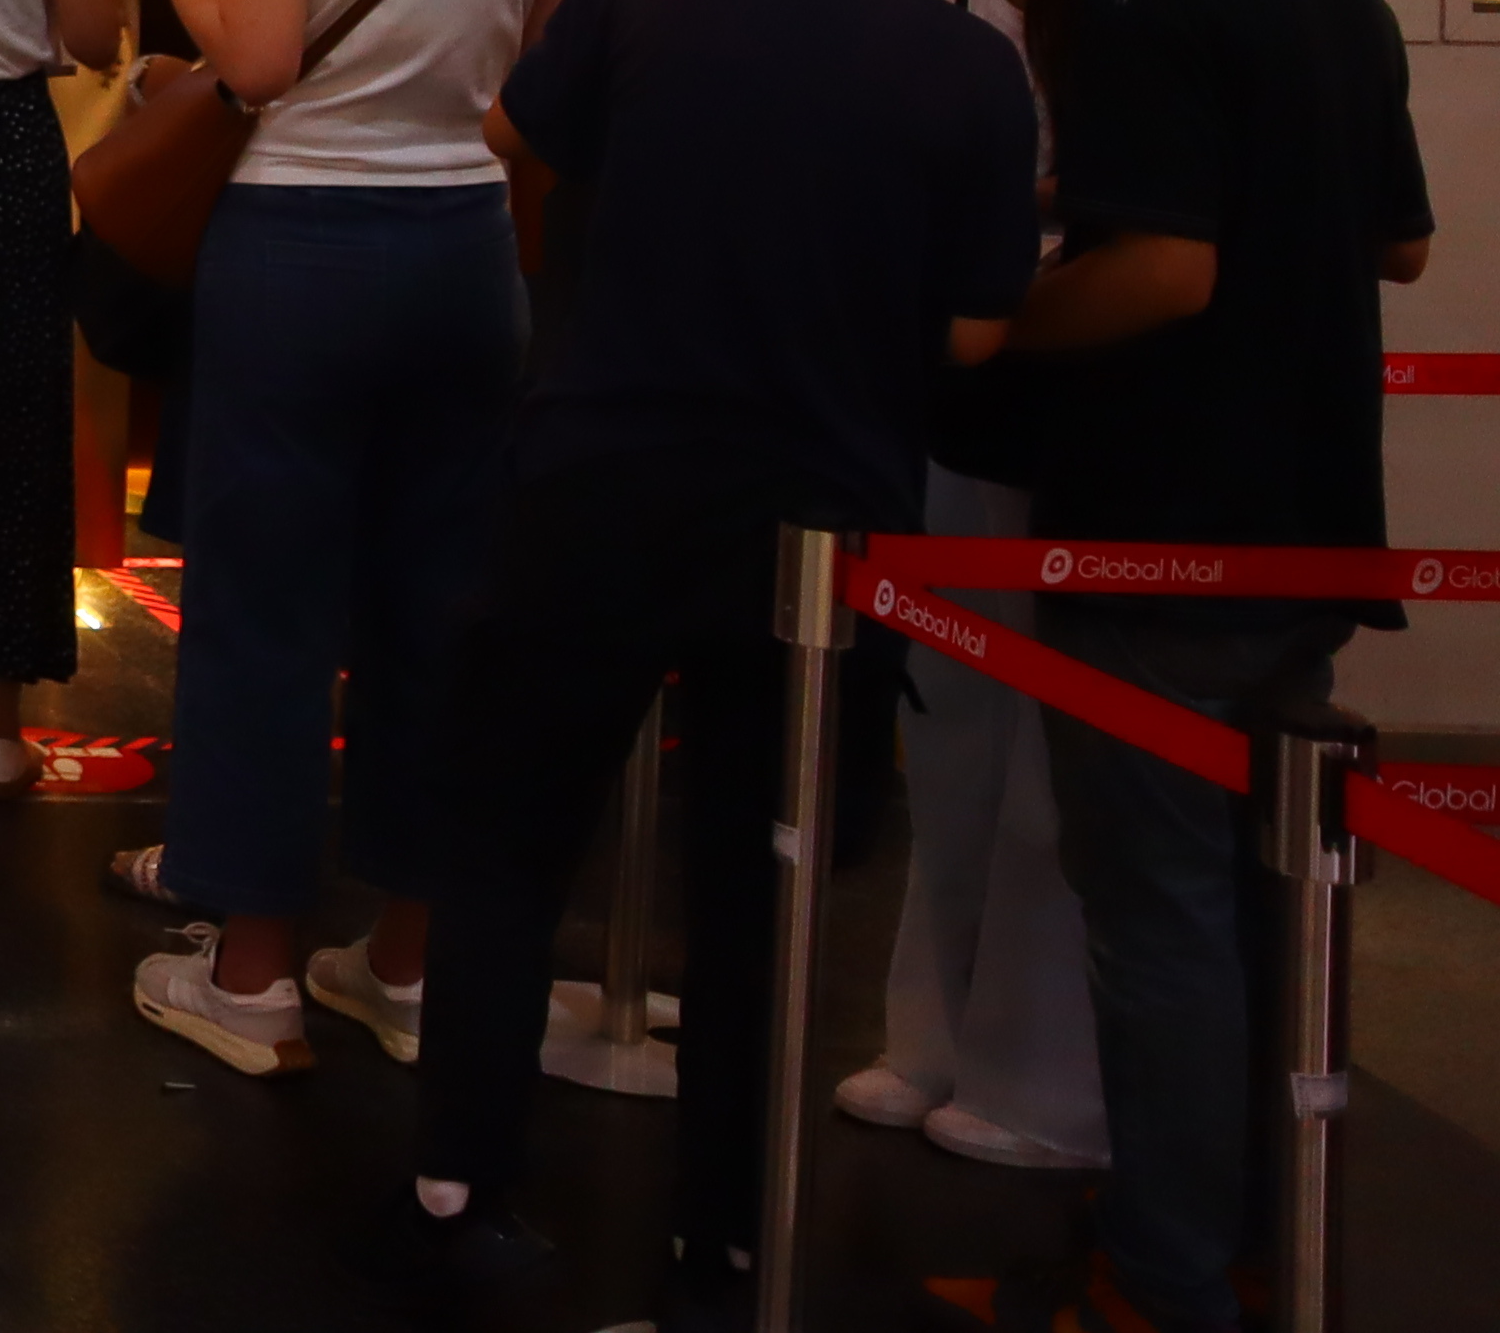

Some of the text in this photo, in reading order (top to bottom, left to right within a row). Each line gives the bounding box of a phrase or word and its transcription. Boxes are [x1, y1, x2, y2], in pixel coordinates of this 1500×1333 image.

[1077, 554, 1225, 584] Global Mall
[896, 594, 988, 660] Global Mall
